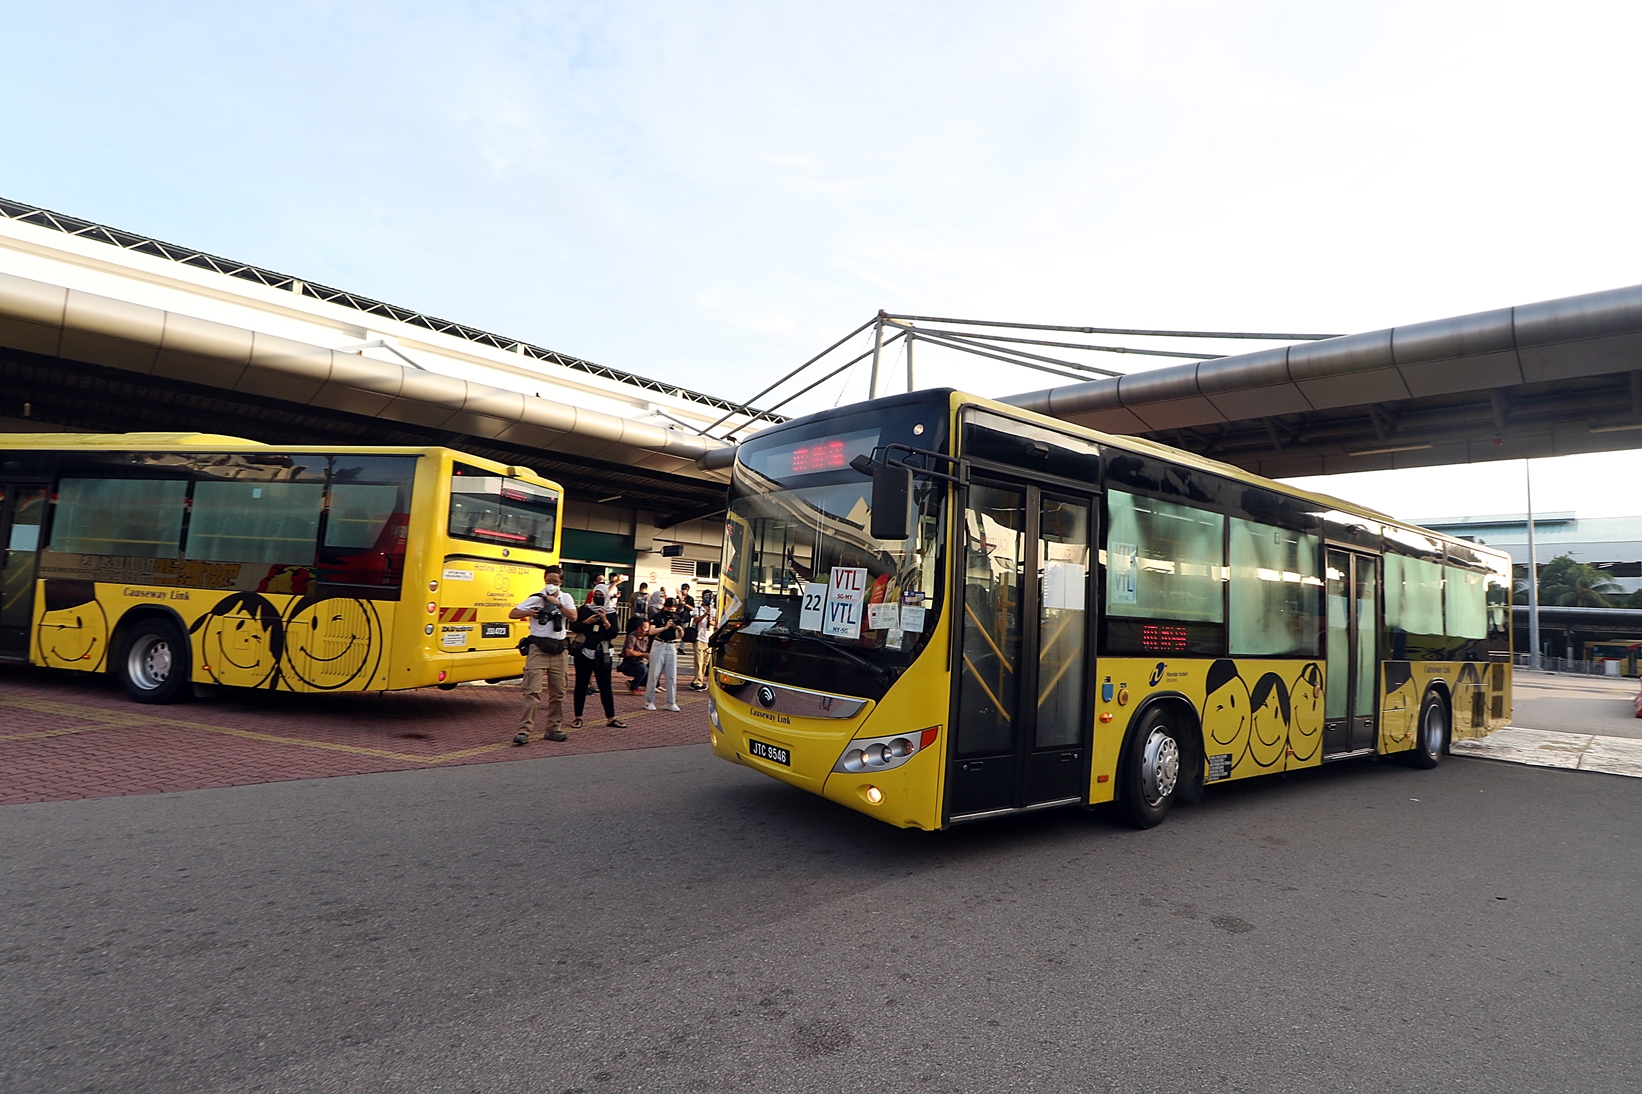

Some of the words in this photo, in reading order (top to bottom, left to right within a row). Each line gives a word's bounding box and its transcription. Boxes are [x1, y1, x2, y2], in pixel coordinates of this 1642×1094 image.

[835, 569, 861, 591] VTL
[123, 587, 167, 601] Causeway
[170, 589, 190, 601] Link
[804, 593, 821, 611] 22
[831, 602, 856, 625] VTL
[750, 707, 776, 723] Causeway
[777, 714, 791, 725] Link
[753, 742, 767, 757] JTC
[767, 746, 787, 763] 9546
